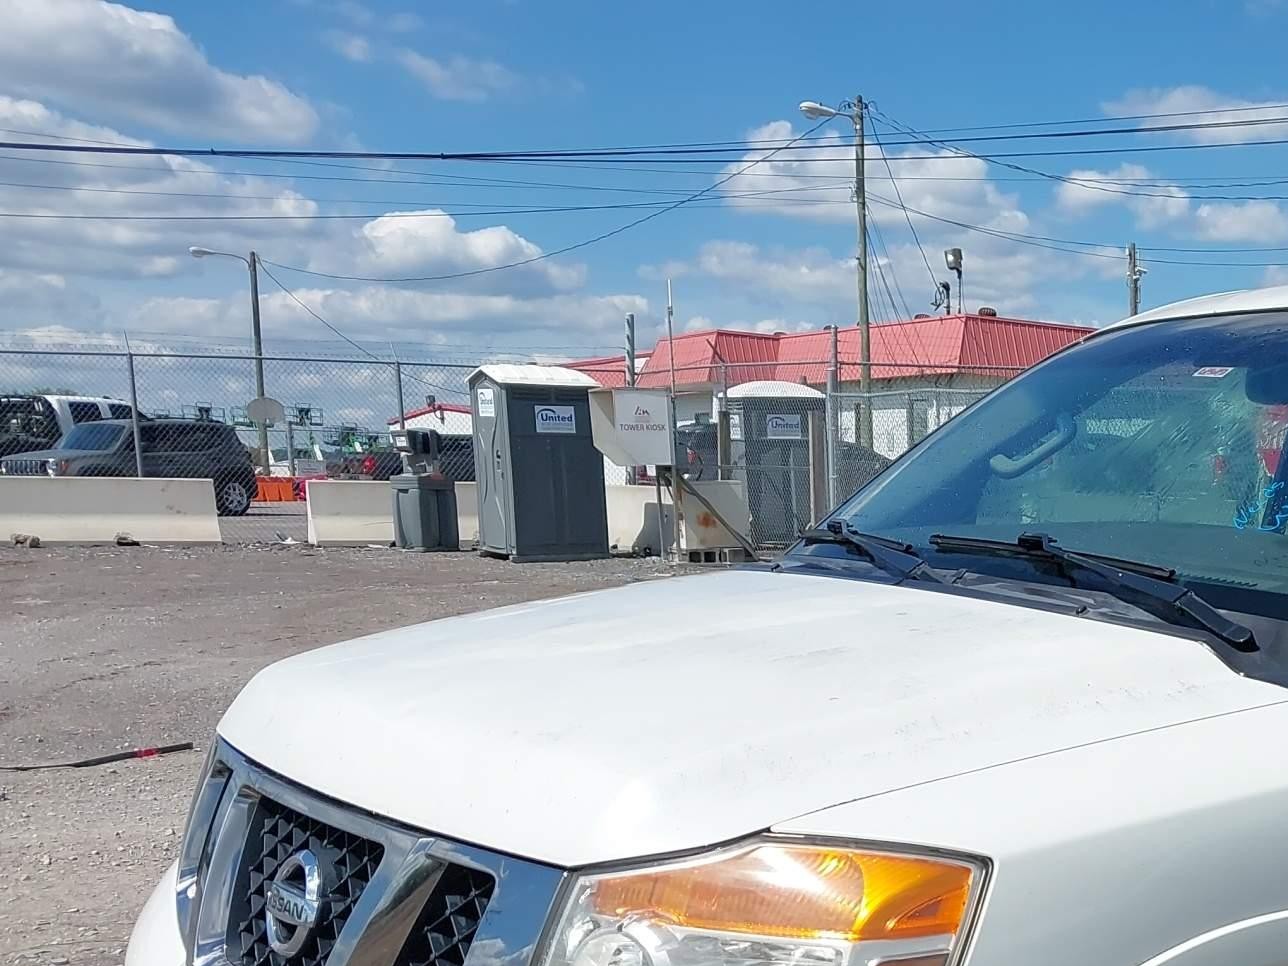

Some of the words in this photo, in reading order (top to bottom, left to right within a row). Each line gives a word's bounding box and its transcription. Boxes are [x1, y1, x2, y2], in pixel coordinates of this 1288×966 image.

[540, 413, 573, 423] United
[619, 423, 645, 431] TOWER
[645, 423, 667, 431] KIOSK
